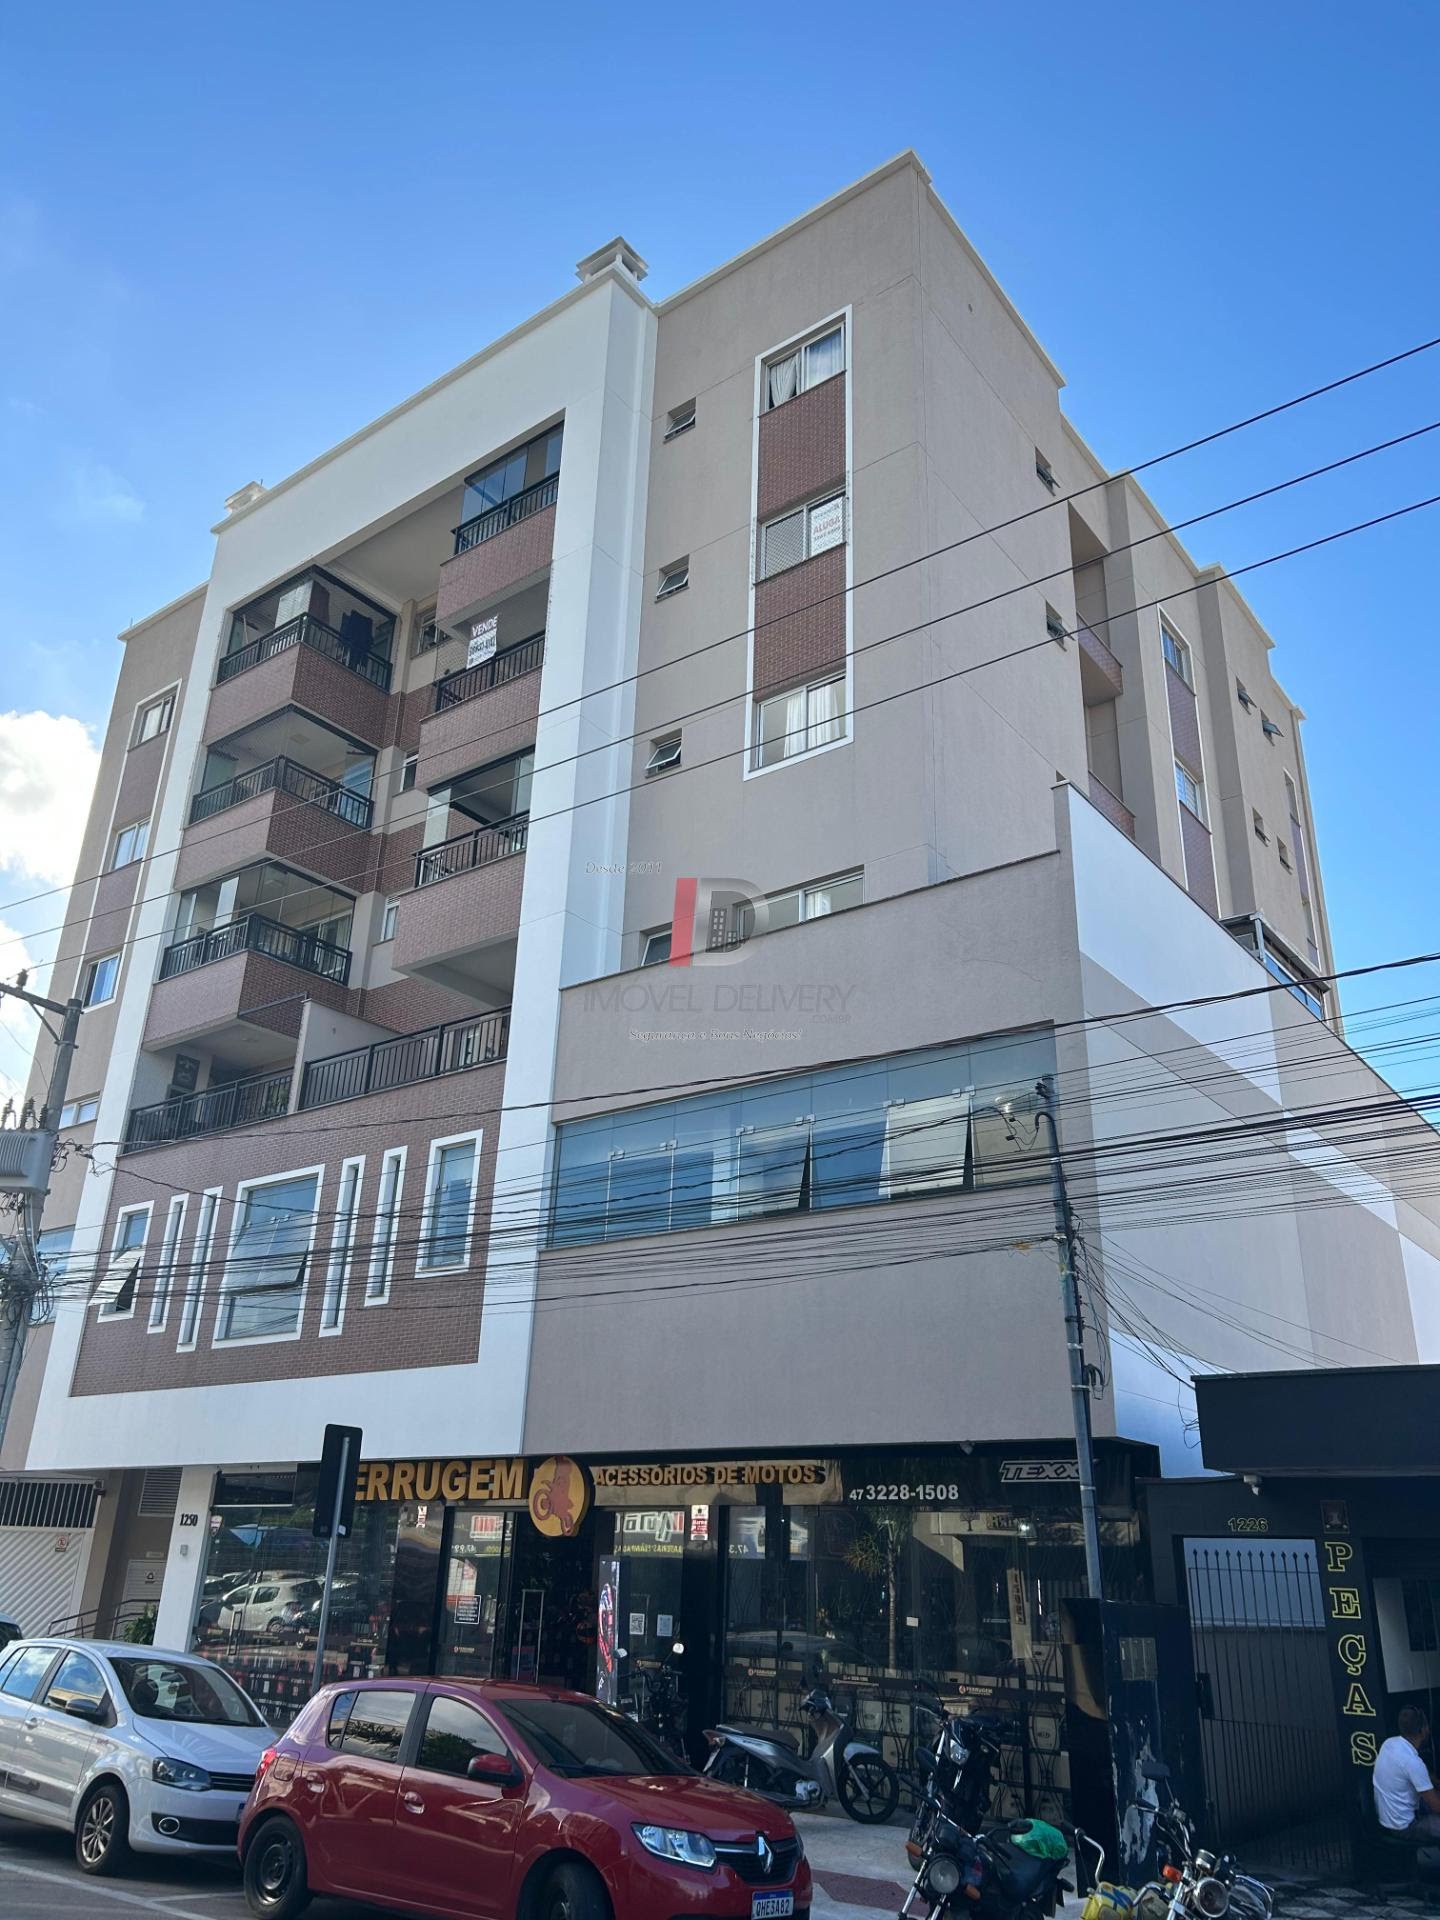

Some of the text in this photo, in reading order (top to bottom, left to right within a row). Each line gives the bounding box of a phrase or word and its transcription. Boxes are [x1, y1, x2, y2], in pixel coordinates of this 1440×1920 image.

[471, 615, 498, 637] VENDE
[354, 1459, 525, 1501] ERRUGEM
[594, 1464, 817, 1486] ACESSÓRIOS DE MOTOS
[849, 1484, 959, 1500] 47 3228-1508
[179, 1513, 198, 1527] 1250
[1228, 1517, 1269, 1532] 1226
[1324, 1541, 1378, 1767] PEÇAS
[756, 1897, 790, 1917] QHE3A82
